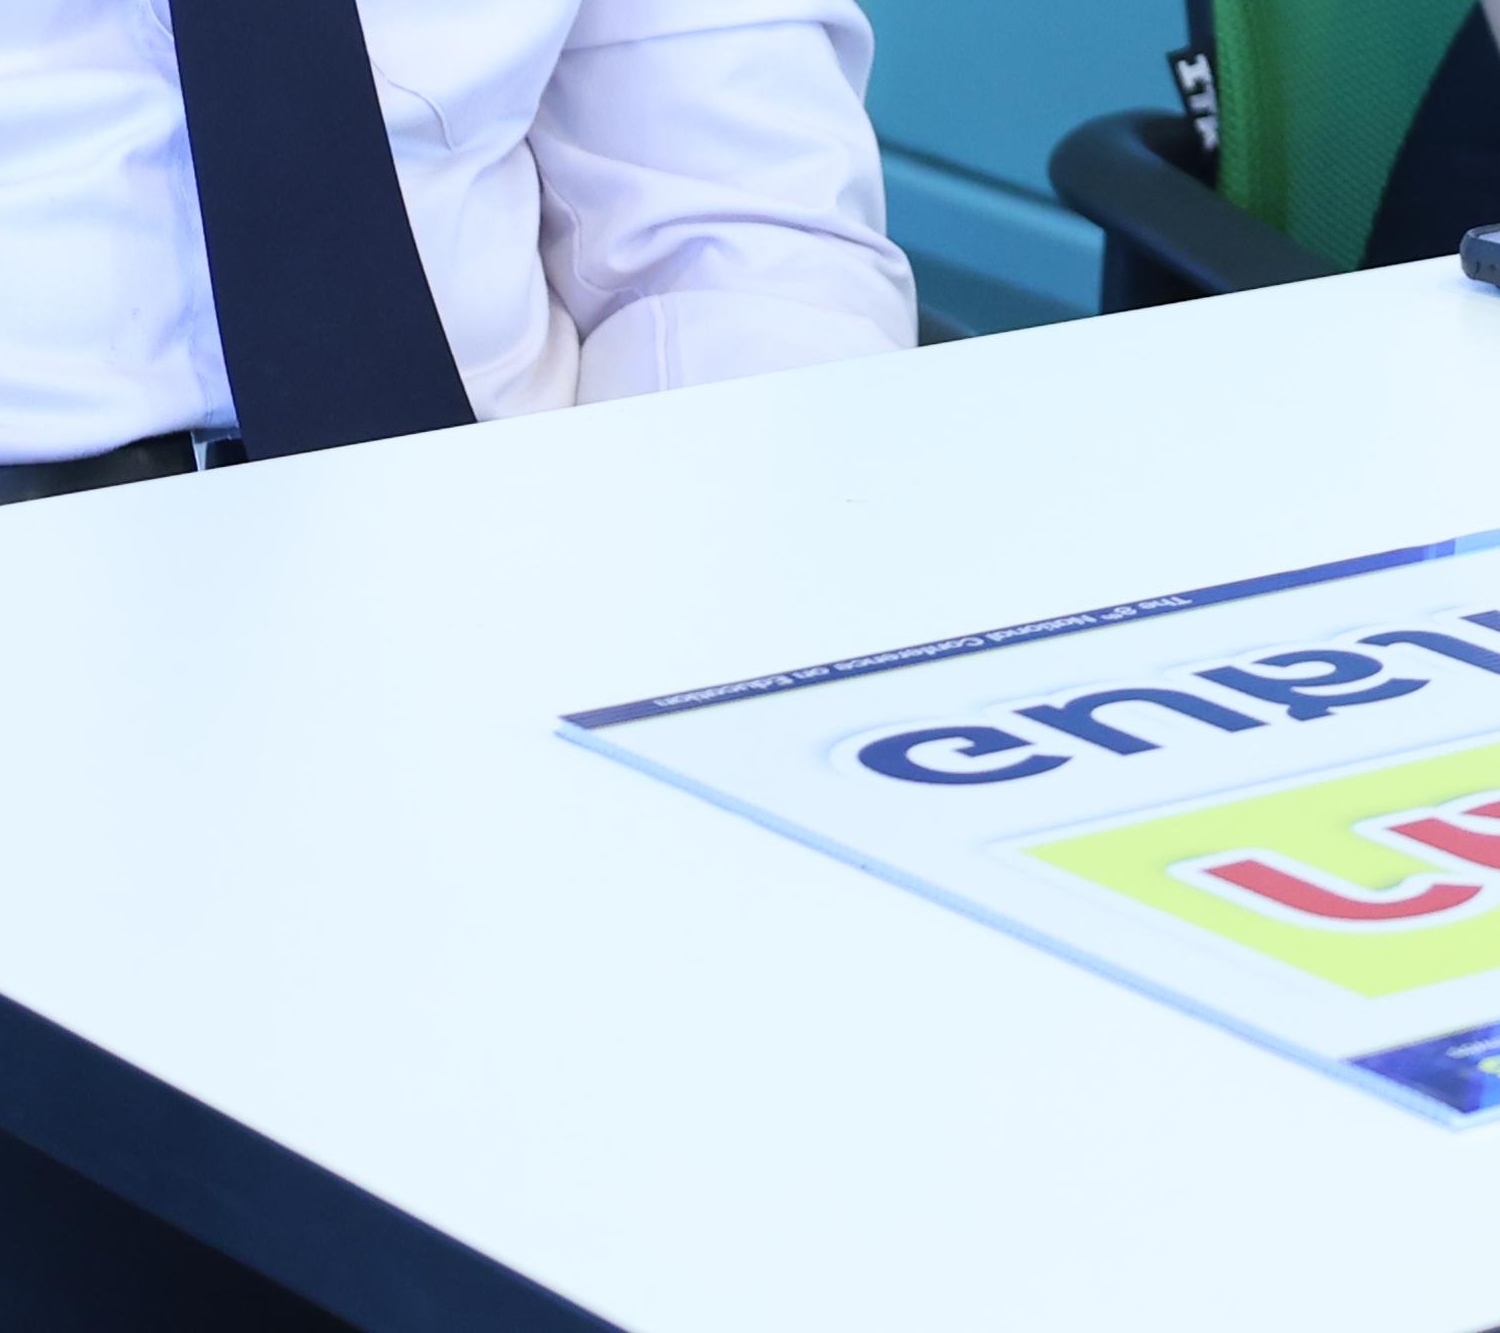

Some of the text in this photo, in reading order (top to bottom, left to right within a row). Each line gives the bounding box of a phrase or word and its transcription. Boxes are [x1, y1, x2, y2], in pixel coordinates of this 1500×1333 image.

[1138, 594, 1193, 611] The
[986, 614, 1097, 645] National
[834, 635, 985, 672] Conference
[793, 667, 831, 684] on
[654, 675, 793, 709] Education
